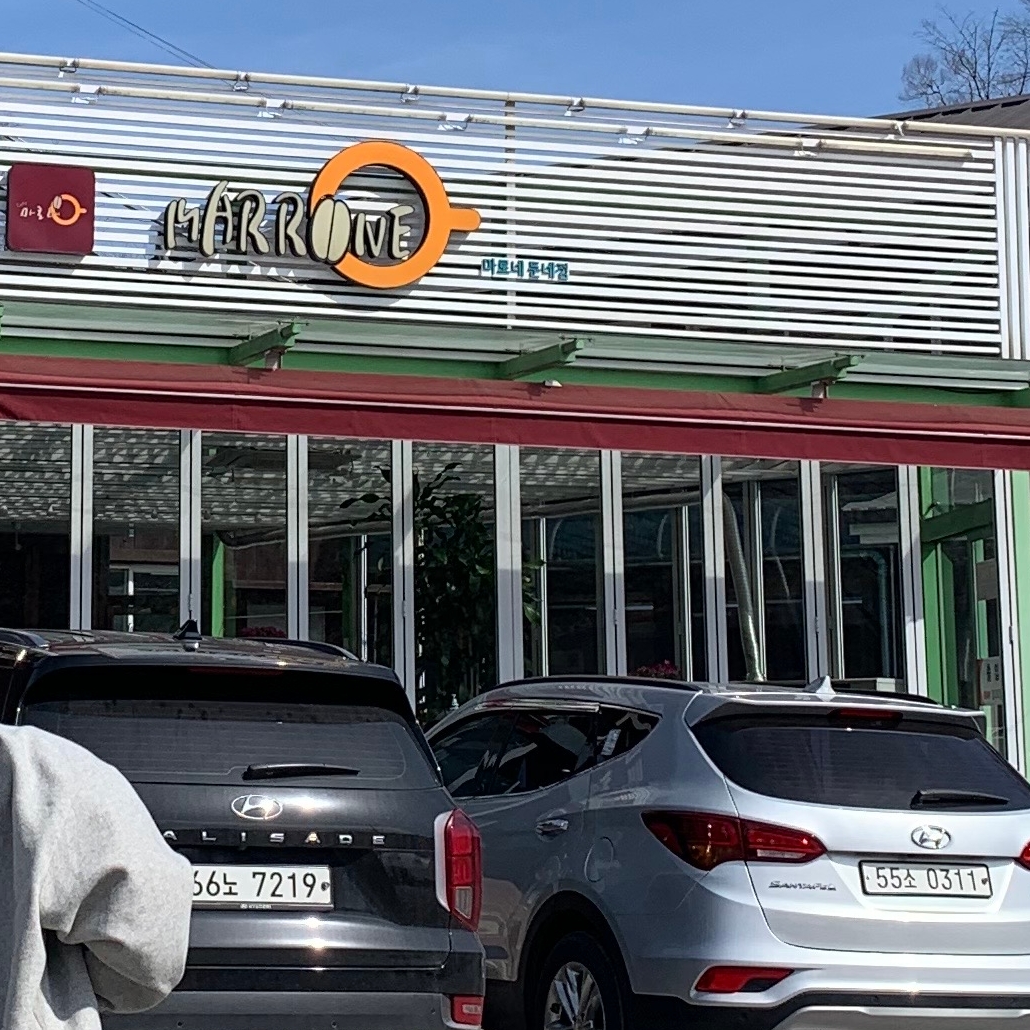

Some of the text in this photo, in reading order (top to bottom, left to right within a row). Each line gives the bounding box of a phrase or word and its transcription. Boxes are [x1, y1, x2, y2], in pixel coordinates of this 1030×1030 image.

[252, 872, 317, 898] 7219
[876, 866, 977, 891] 55소 0311
